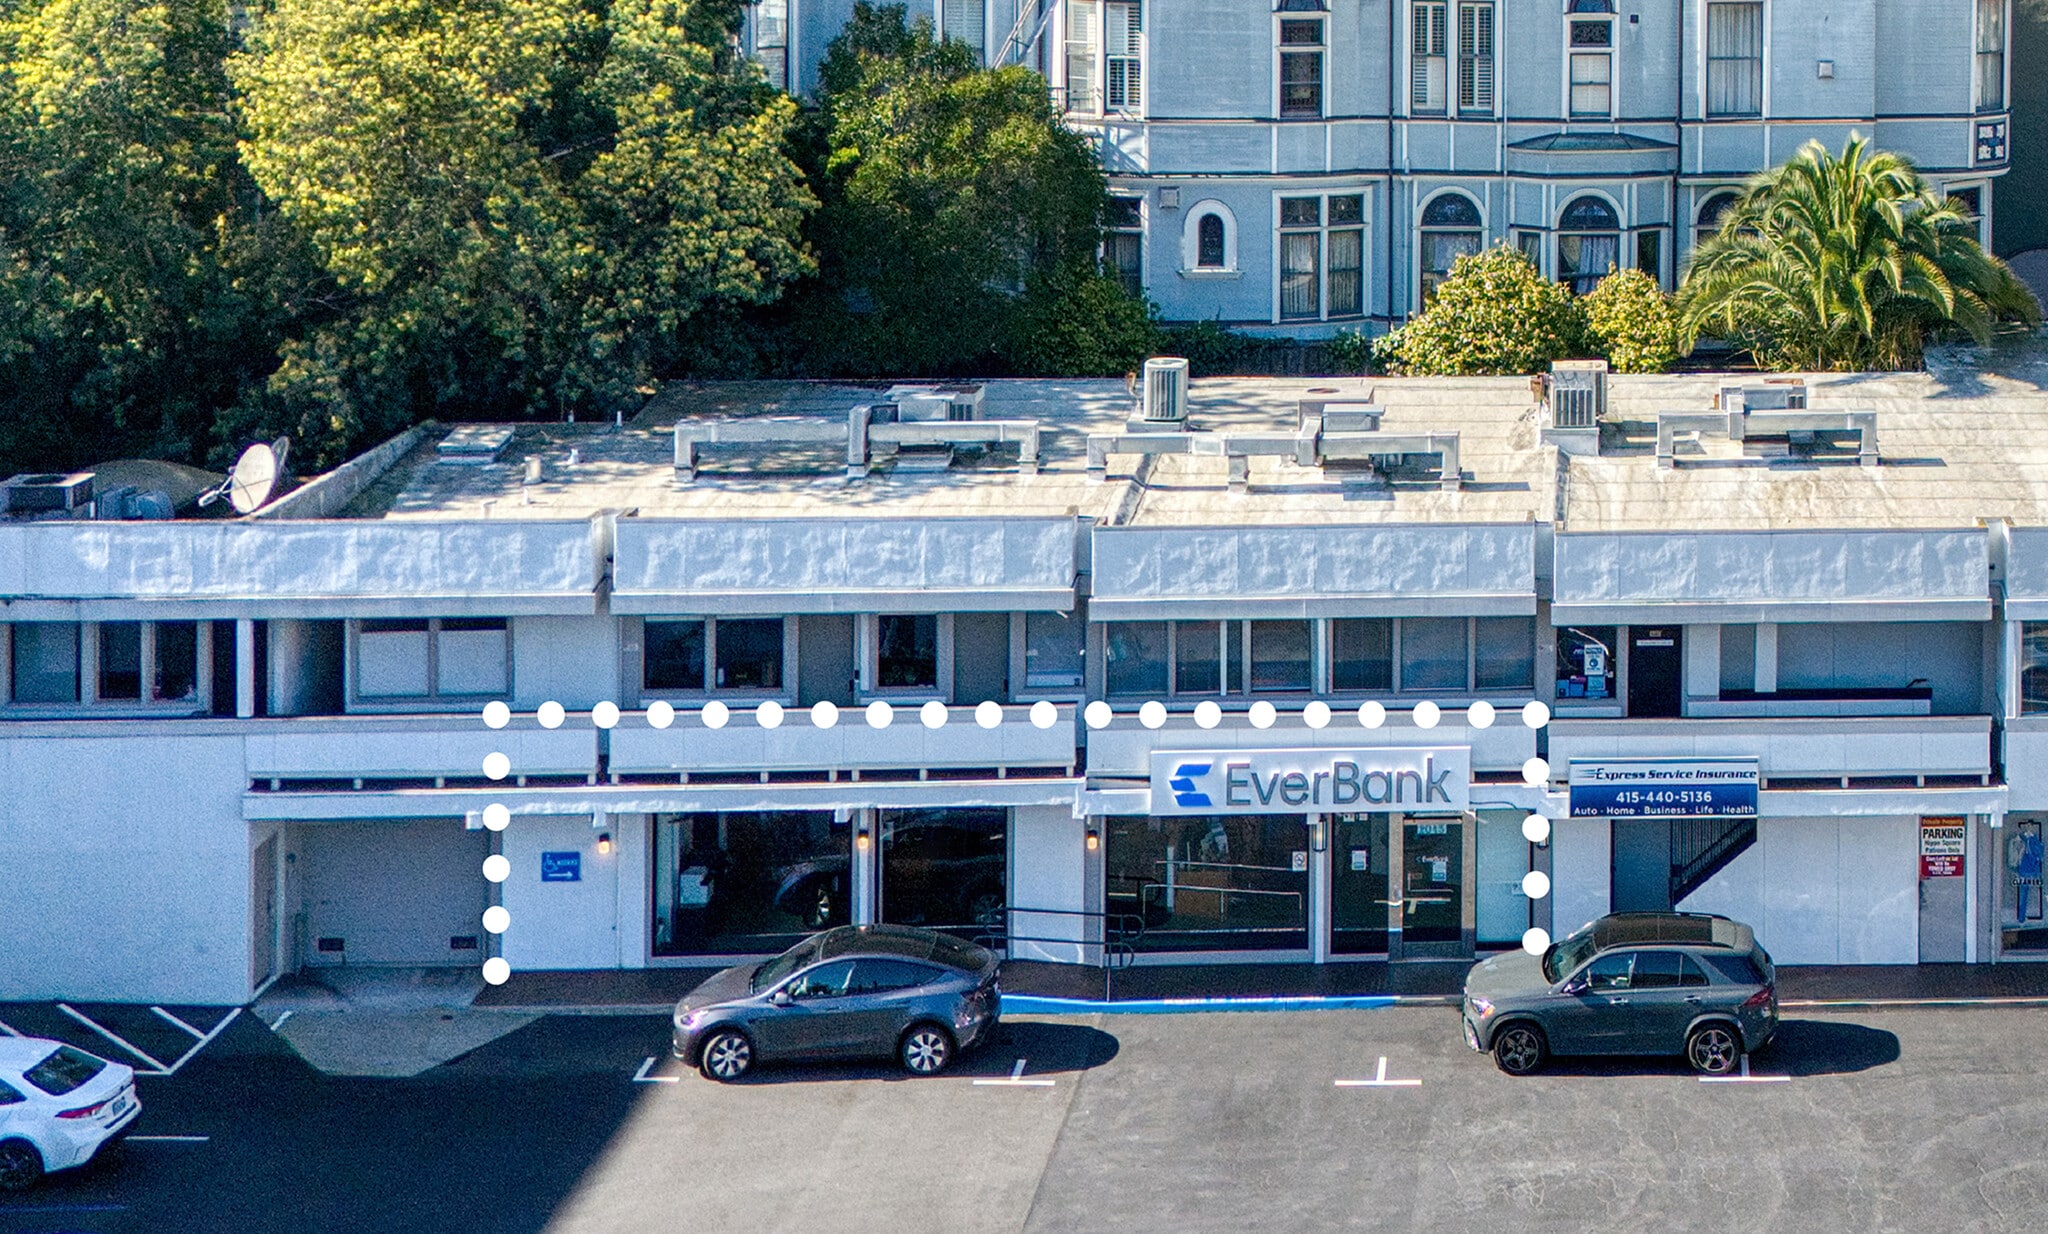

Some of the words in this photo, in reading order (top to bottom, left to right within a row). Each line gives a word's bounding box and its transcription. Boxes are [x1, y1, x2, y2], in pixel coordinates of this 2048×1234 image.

[1595, 767, 1646, 781] Express
[1647, 769, 1693, 779] Service
[1695, 769, 1757, 779] Insurance
[1226, 757, 1451, 806] EverBank
[1616, 791, 1712, 803] 415-440-5136
[1644, 807, 1688, 815] Business
[1695, 806, 1713, 814] Life
[1722, 806, 1755, 814] Health
[1922, 828, 1963, 839] PARKING
